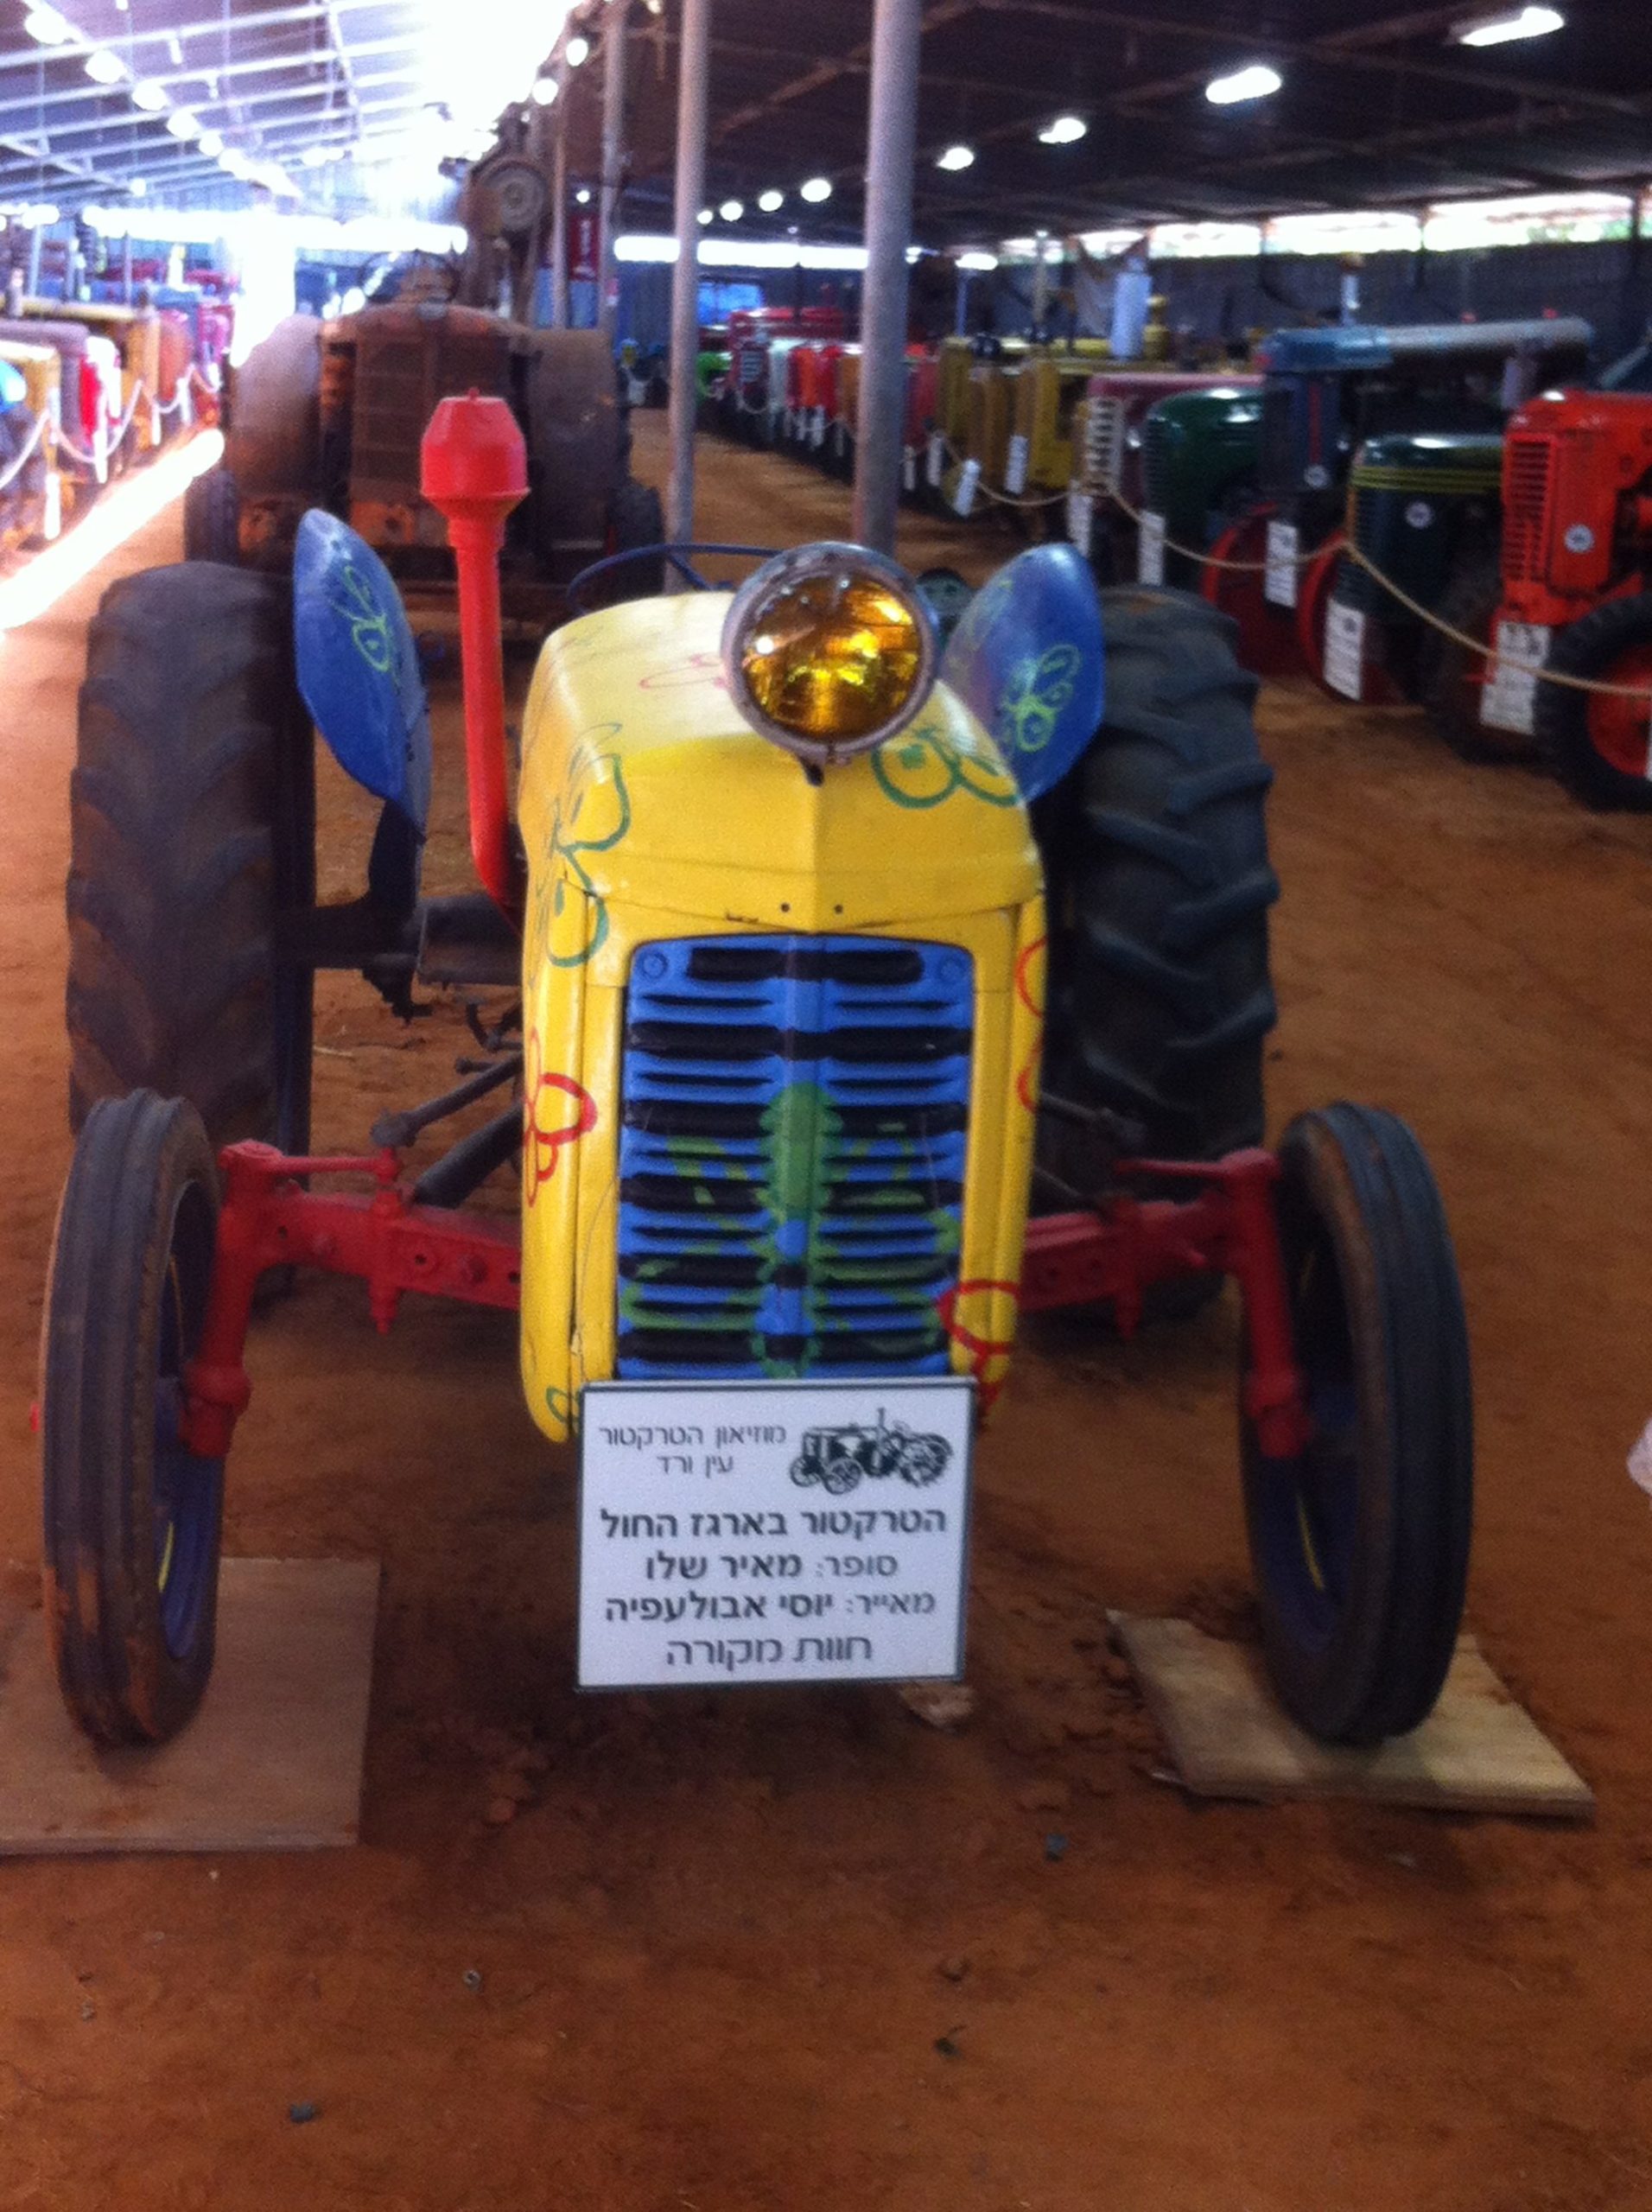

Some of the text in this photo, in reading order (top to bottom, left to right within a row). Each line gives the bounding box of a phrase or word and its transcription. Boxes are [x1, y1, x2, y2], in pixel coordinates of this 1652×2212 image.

[600, 1425, 786, 1451] מוזיאון הטרקטור
[658, 1454, 734, 1479] עין ורד
[600, 1508, 946, 1541] הטרקטור בארגז החול
[645, 1550, 899, 1580] סופר: מאיר שלו
[606, 1591, 936, 1622] מאייר: יוסי אבולעפיה
[667, 1637, 872, 1672] חוות מקורה
